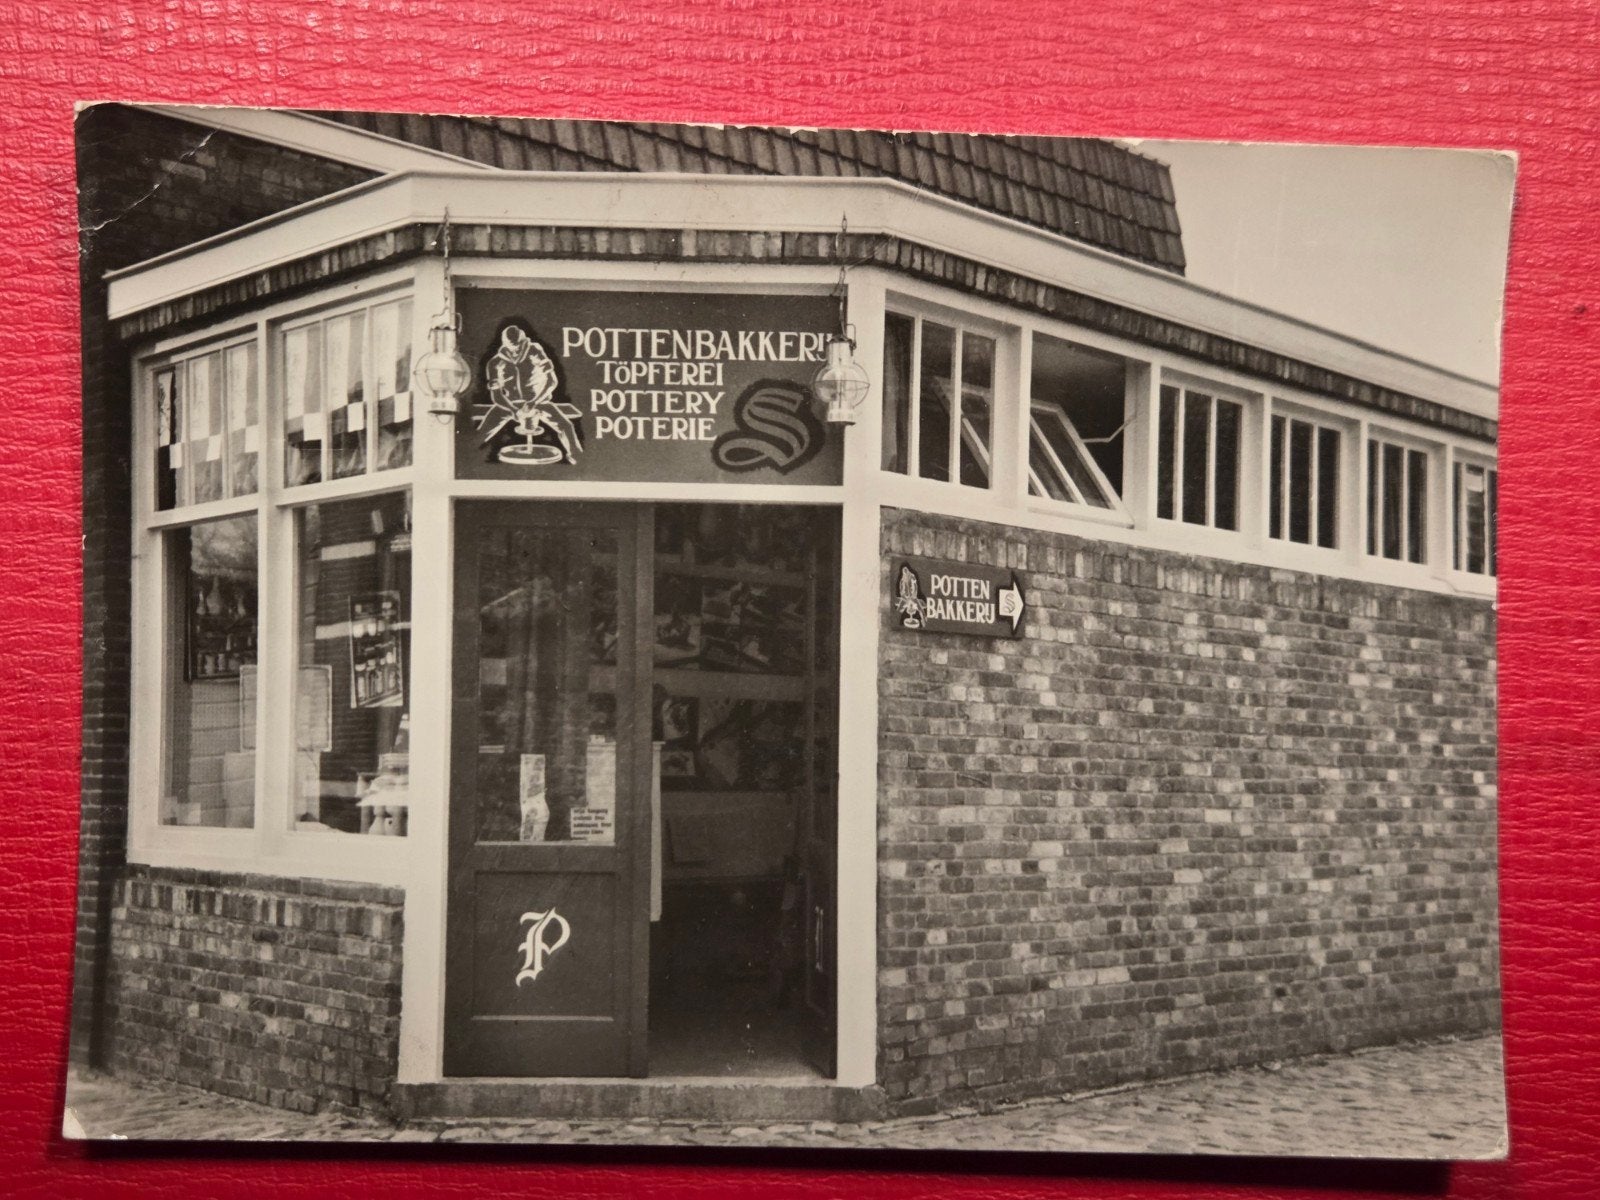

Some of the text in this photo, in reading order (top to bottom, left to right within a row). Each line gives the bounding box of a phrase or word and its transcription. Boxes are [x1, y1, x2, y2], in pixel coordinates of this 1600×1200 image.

[596, 361, 724, 386] TÖPFEREI
[590, 389, 725, 414] POTTERY
[595, 416, 718, 440] POTERIE
[931, 574, 990, 600] POTTEN
[926, 597, 995, 624] BAKKERIJ
[516, 907, 571, 987] P
